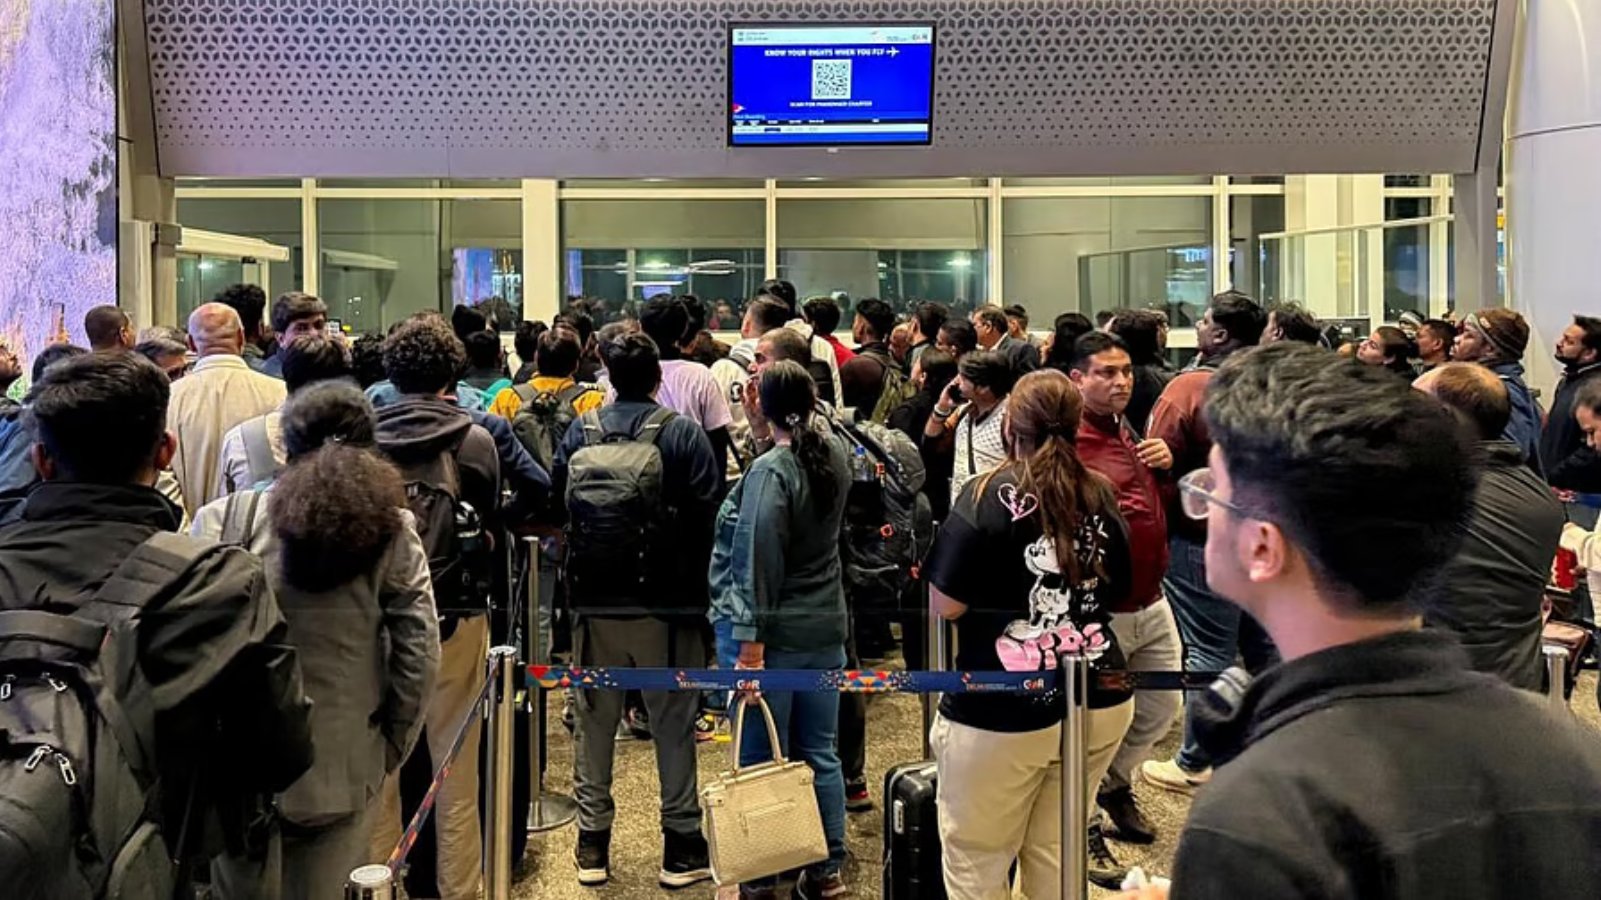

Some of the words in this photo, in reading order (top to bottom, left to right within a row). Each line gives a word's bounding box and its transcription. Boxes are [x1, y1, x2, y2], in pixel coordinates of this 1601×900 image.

[808, 49, 833, 57] RIGHTS
[834, 49, 855, 57] WHEN
[857, 48, 871, 56] YOU
